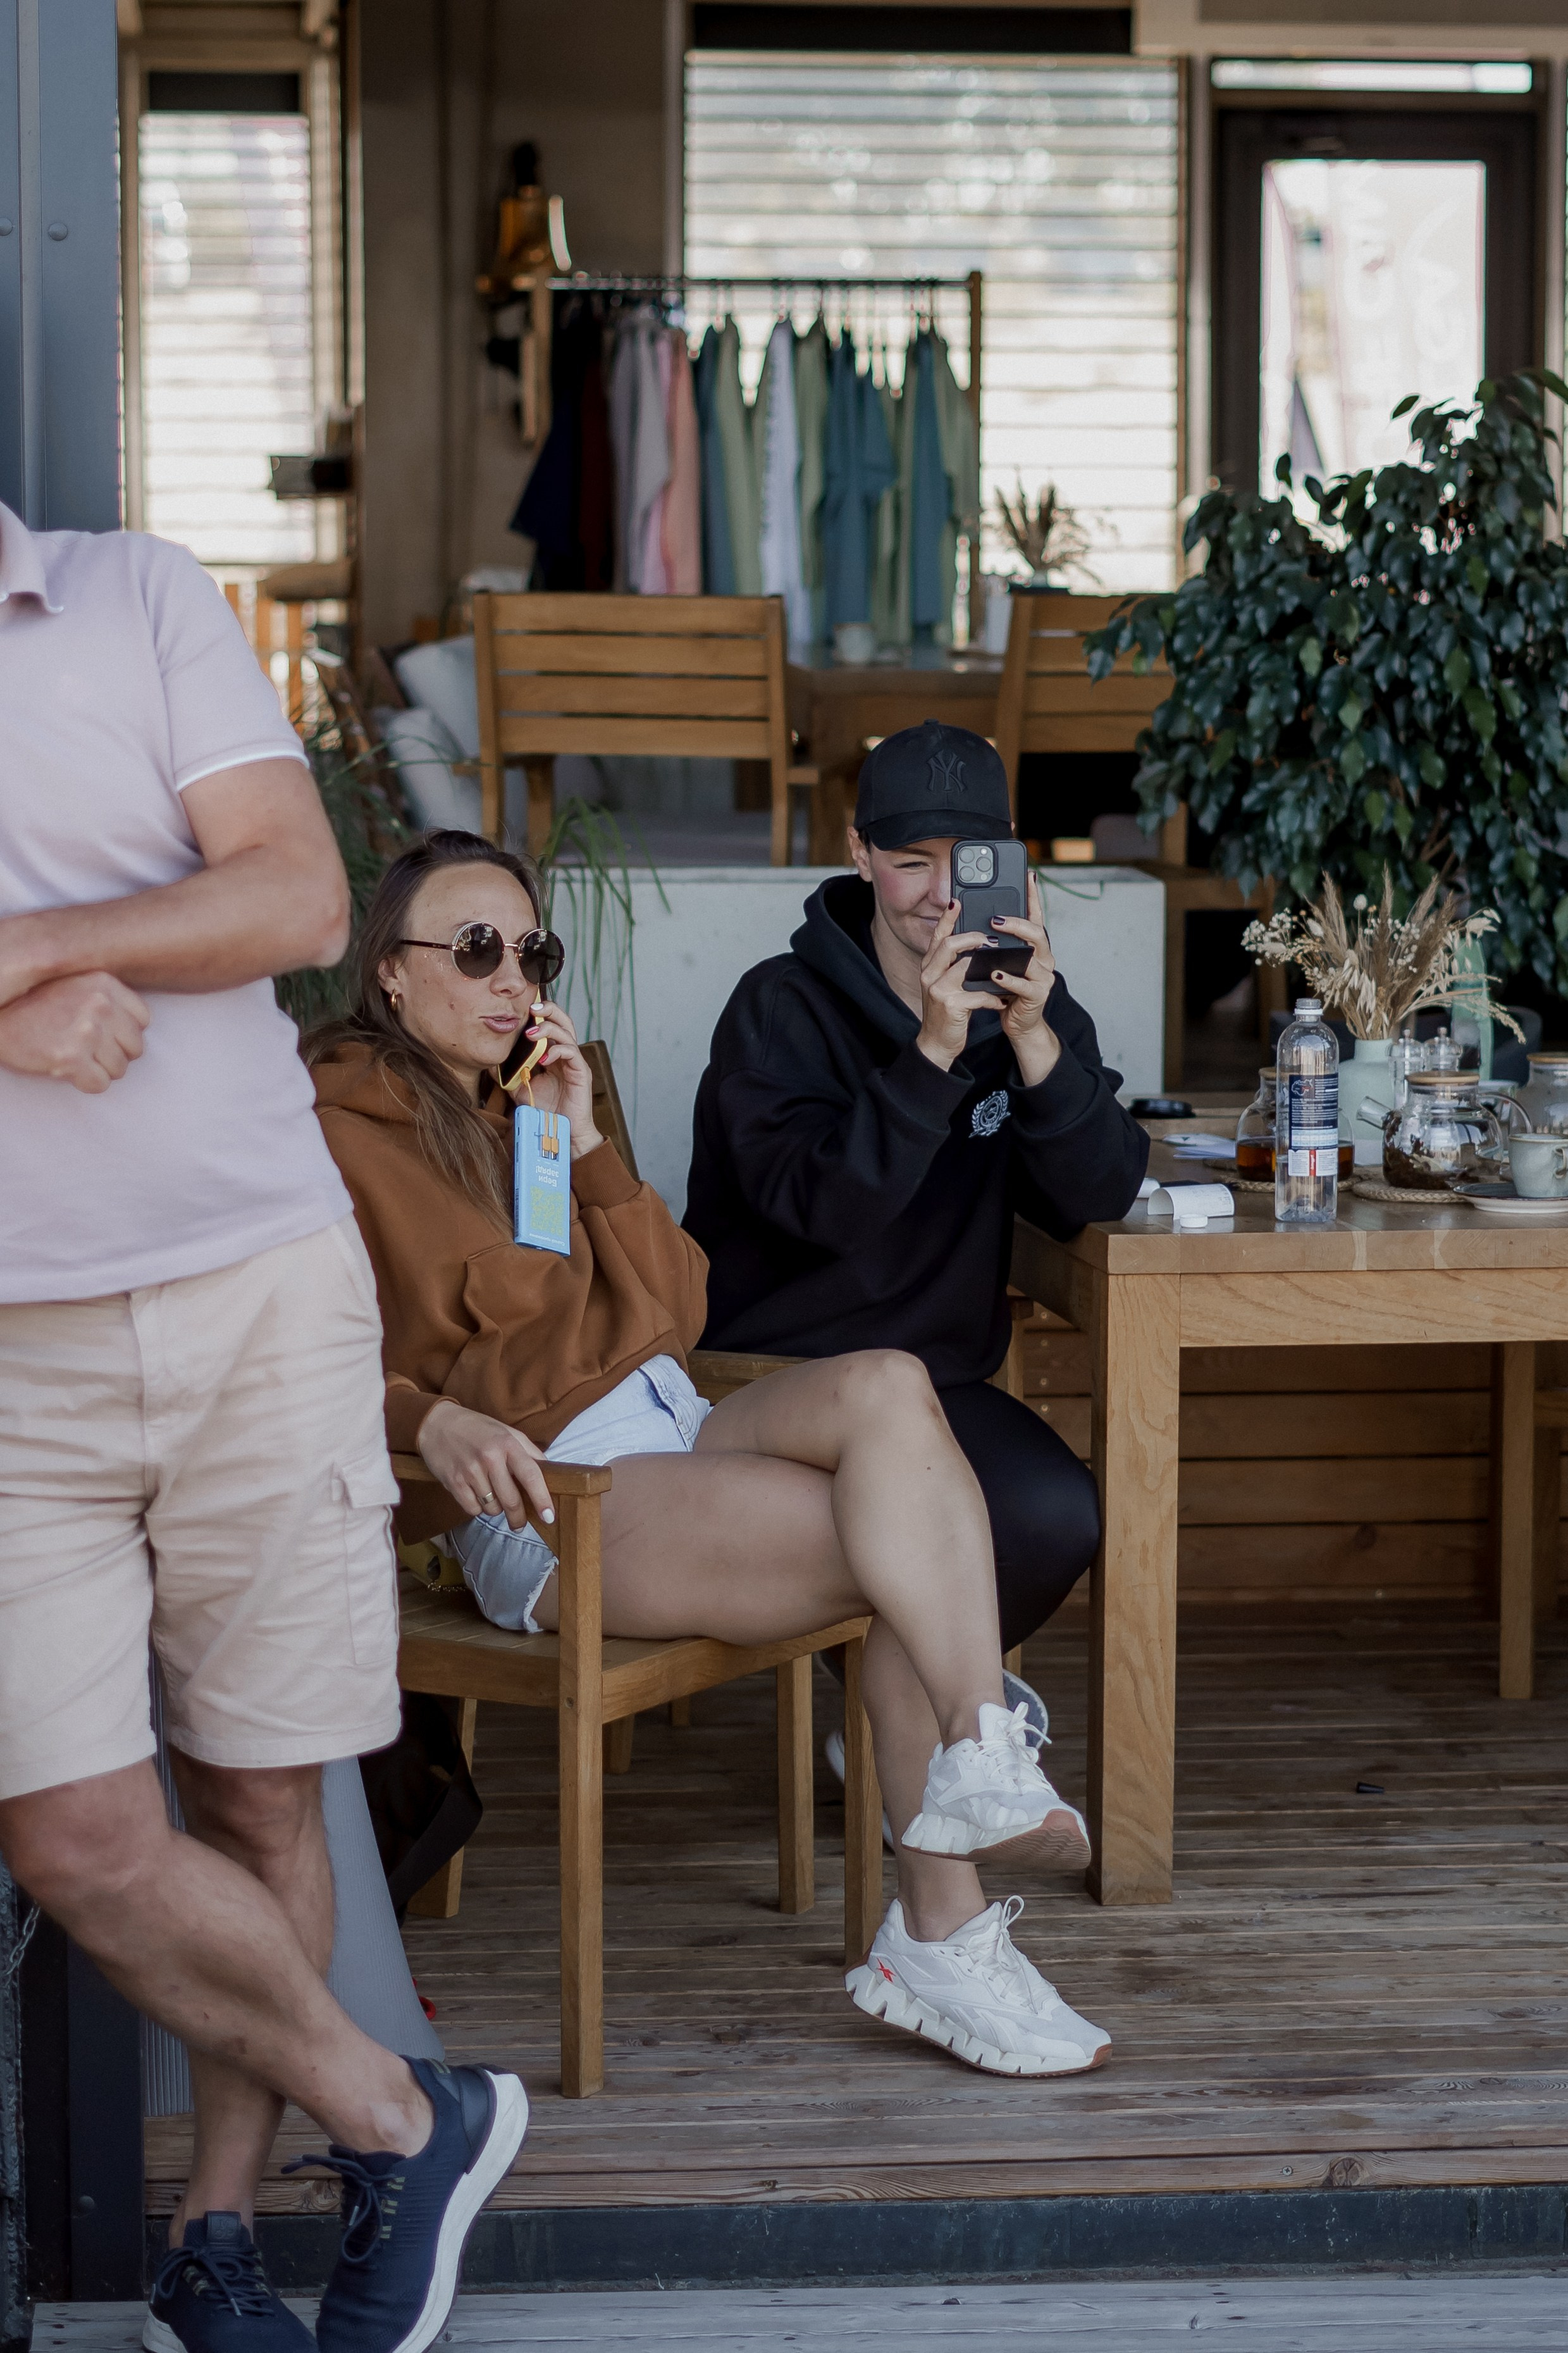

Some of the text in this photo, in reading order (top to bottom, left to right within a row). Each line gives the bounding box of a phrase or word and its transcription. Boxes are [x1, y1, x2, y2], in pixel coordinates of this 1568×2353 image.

[926, 748, 967, 792] NY
[536, 1165, 559, 1177] заряд!
[538, 1175, 557, 1187] Бери
